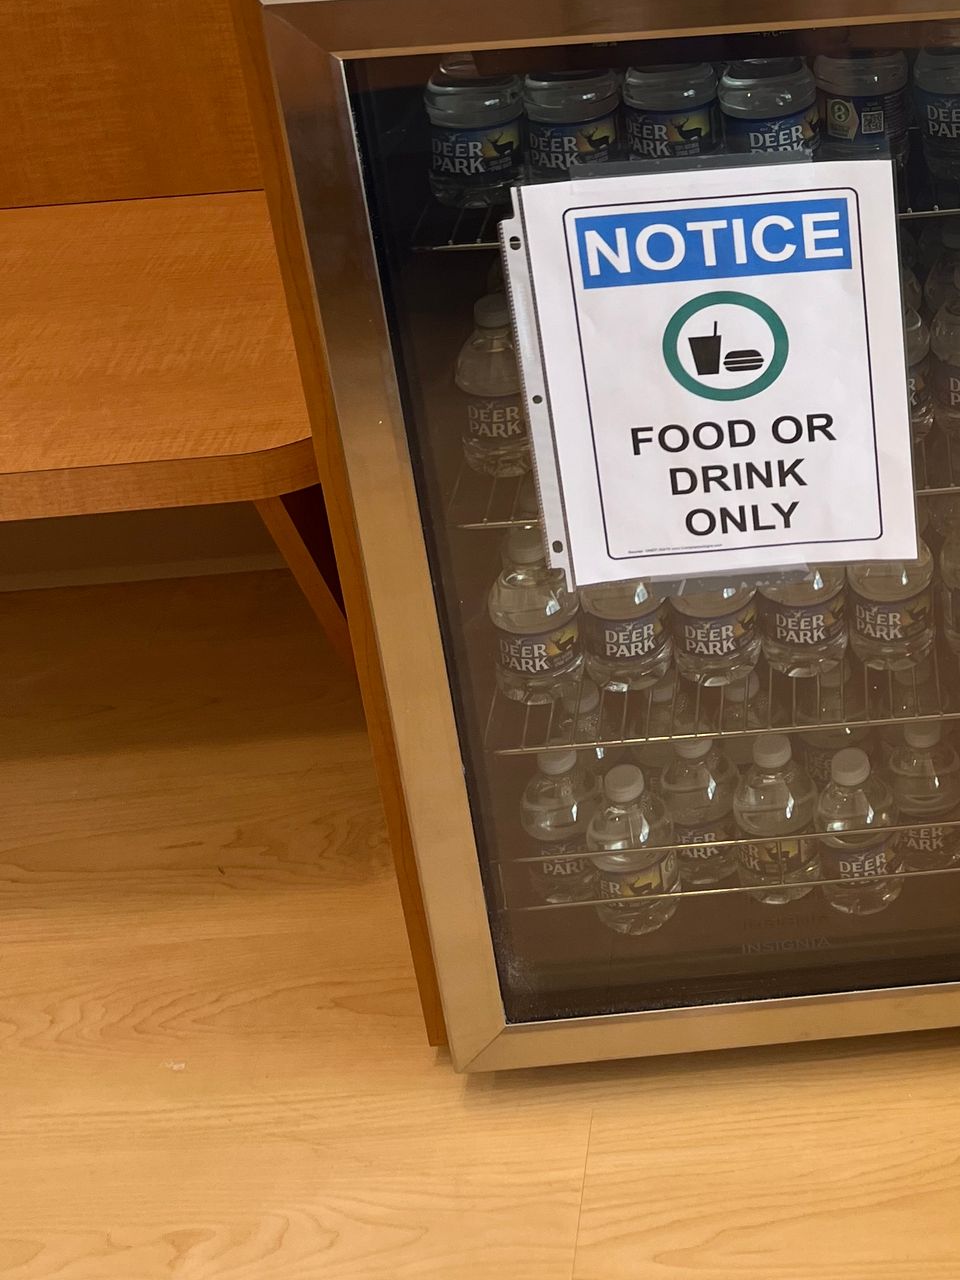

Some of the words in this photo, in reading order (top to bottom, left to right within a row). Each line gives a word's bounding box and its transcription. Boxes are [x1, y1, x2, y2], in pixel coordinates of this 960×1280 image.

[529, 132, 578, 152] DEER
[749, 124, 805, 148] DEER
[432, 138, 484, 157] DEER
[433, 156, 486, 176] PARK
[531, 151, 582, 170] PARK
[583, 211, 844, 276] NOTICE
[468, 404, 520, 422] DEER
[470, 420, 521, 438] PARK
[630, 419, 756, 455] FOOD
[771, 412, 837, 442] OR
[669, 458, 808, 495] DRINK
[685, 501, 800, 536] ONLY
[776, 612, 825, 630] DEER
[856, 603, 901, 626] DEER
[604, 623, 655, 643] DEER
[684, 623, 735, 642] DEER
[776, 626, 827, 644] PARK
[857, 621, 903, 641] PARK
[500, 639, 548, 657] DEER
[605, 638, 656, 658] PARK
[685, 638, 737, 656] PARK
[501, 655, 551, 674] PARK
[905, 826, 944, 838] EER
[905, 838, 945, 852] ARK
[839, 852, 887, 873] DEER
[741, 936, 832, 955] INSIGNIA
